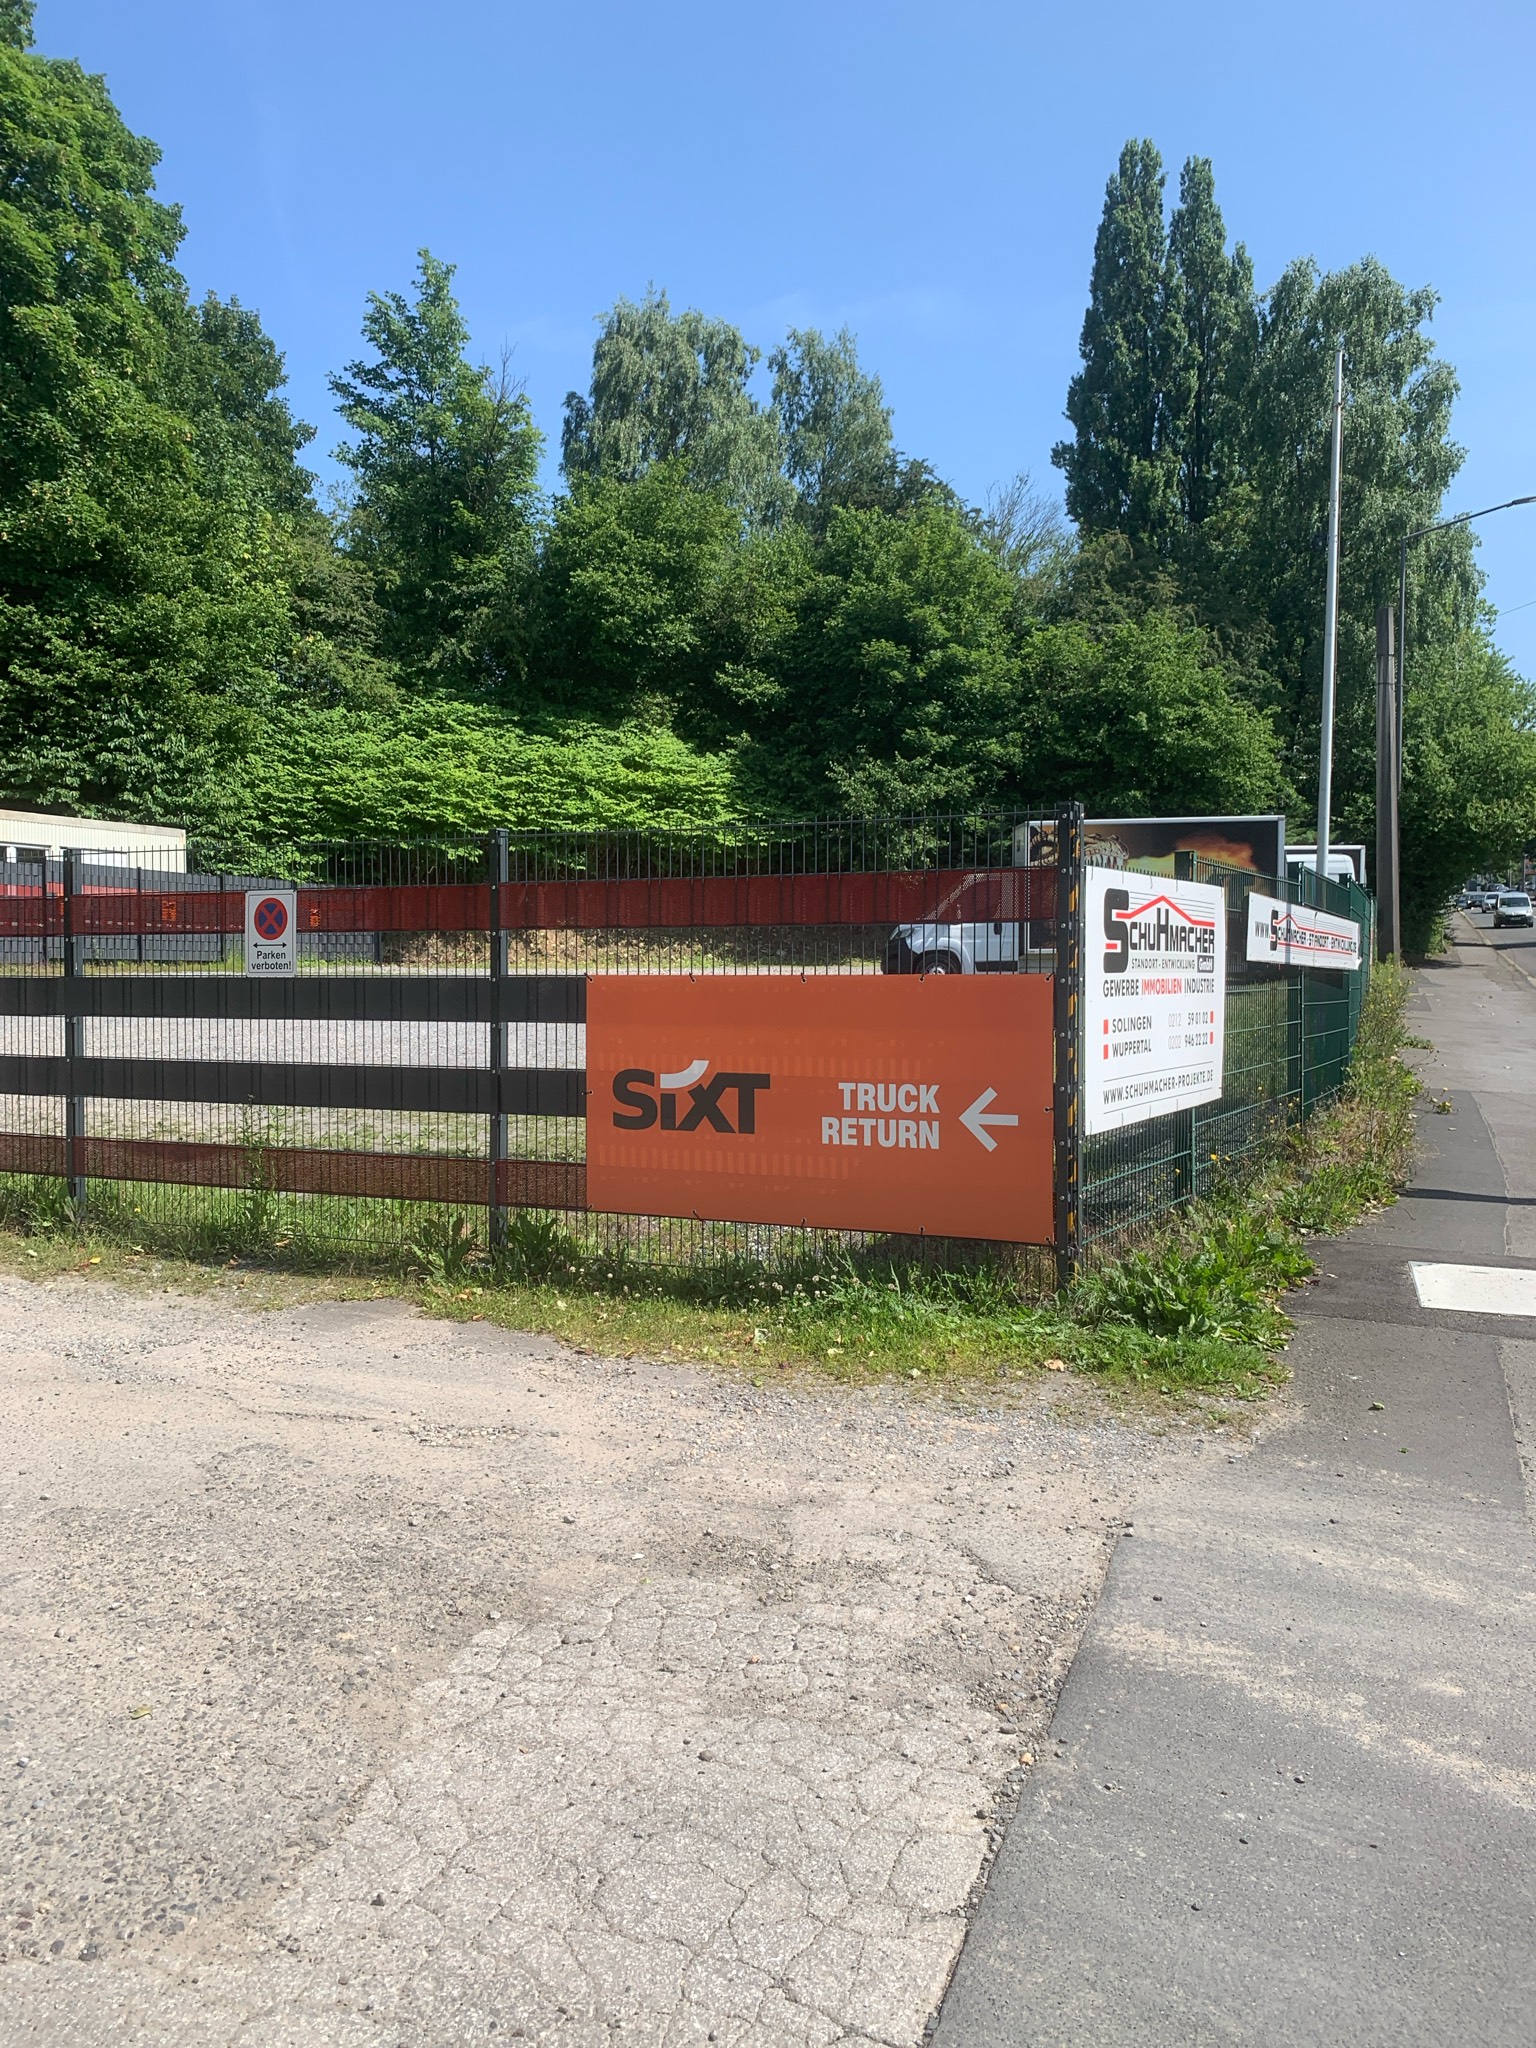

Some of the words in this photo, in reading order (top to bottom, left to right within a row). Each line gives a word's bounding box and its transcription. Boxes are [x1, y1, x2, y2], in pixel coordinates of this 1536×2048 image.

[256, 950, 286, 960] Parken
[251, 961, 292, 970] verboten!
[1103, 979, 1139, 998] GEWERBE
[1141, 978, 1182, 995] IMMOBILIEN
[1184, 978, 1215, 994] INDUSTRIE
[1112, 1015, 1152, 1034] SOLINGEN
[1112, 1039, 1152, 1058] WUPPERTAL
[1103, 1069, 1214, 1105] WWW.SCHUHMACHER-PROJEKTE.DE
[838, 1082, 940, 1114] TRUCK
[821, 1116, 940, 1150] RETURN
